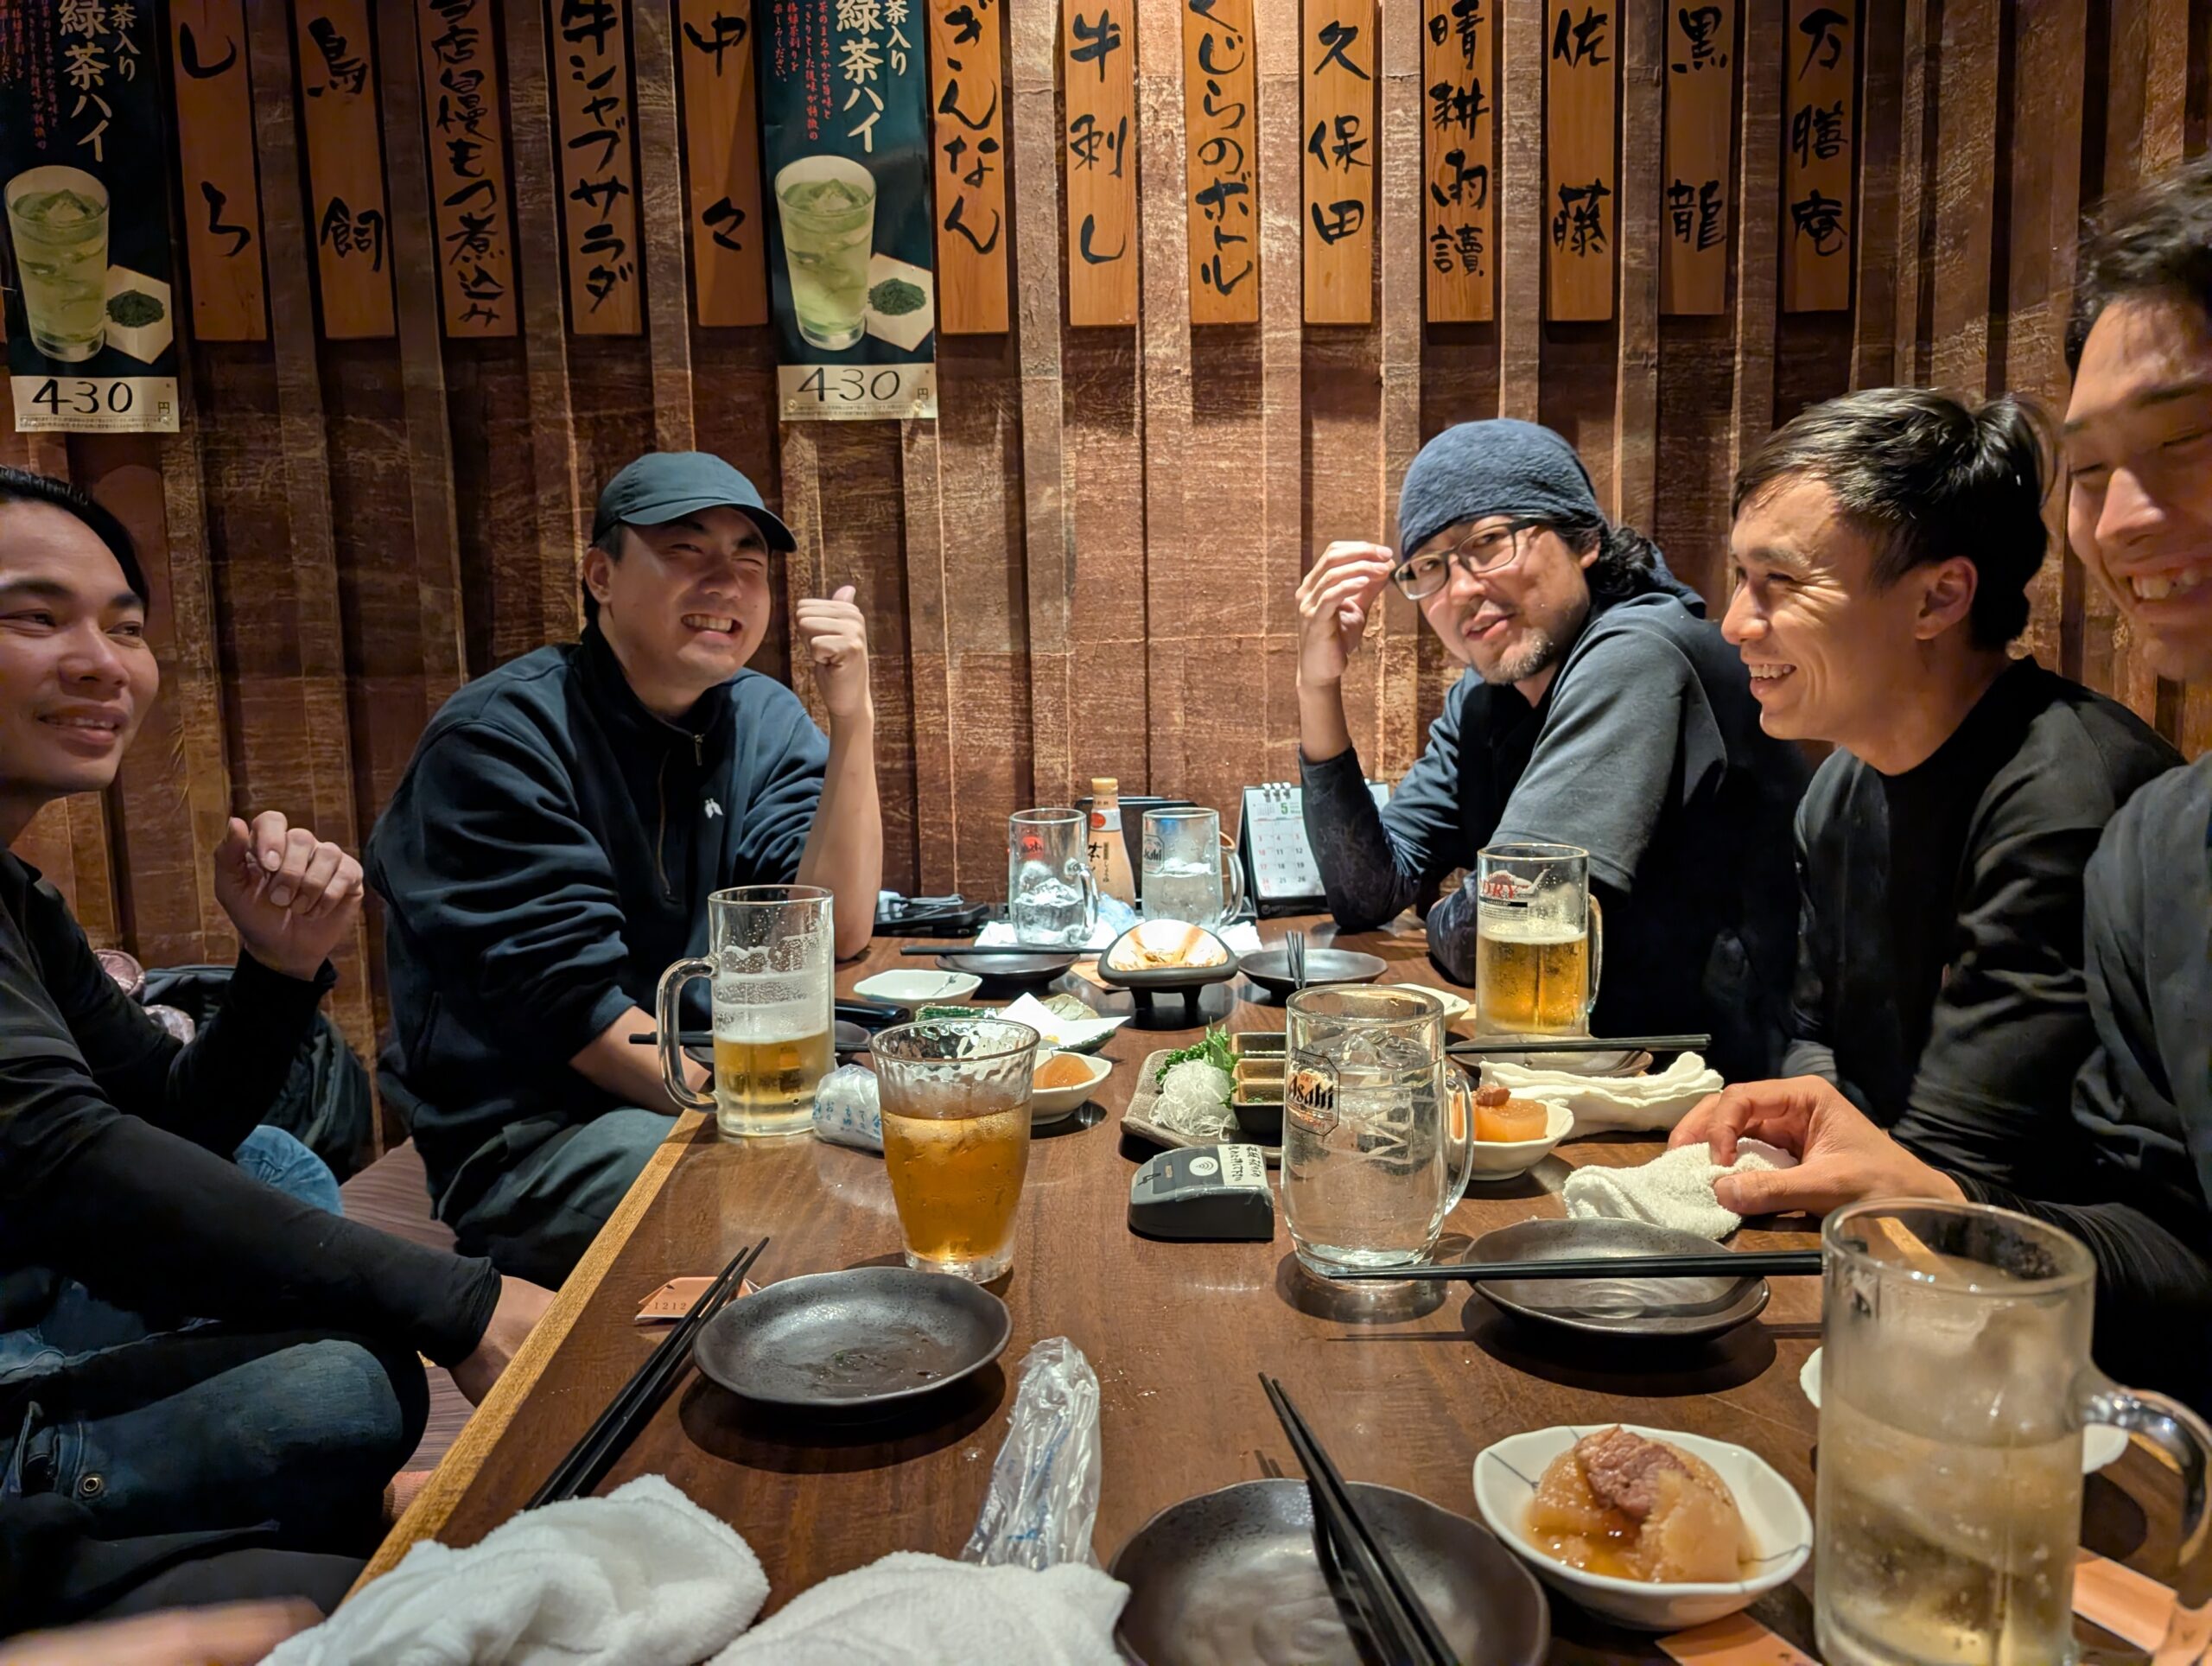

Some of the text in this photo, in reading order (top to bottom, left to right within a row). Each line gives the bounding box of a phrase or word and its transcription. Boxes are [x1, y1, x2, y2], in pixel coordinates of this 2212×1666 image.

[58, 0, 113, 162] 緑茶ハイ
[109, 3, 141, 82] 茶入り
[836, 0, 886, 153] 緑茶ハイ
[883, 0, 912, 76] 茶入り
[308, 17, 384, 271] 鳥飼
[560, 0, 632, 312] 牛シャブサラダ
[684, 12, 746, 251] 中々
[938, 0, 1000, 254] ぎんなん
[1070, 9, 1128, 264] 牛刺し
[1307, 20, 1371, 245] 久保田
[1552, 6, 1611, 258] 佐藤
[1668, 6, 1728, 251] 黒龍
[1791, 9, 1849, 257] 万膳庵
[32, 378, 170, 415] 430 円
[798, 367, 928, 402] 430 円
[1281, 802, 1288, 815] 5
[1482, 880, 1519, 900] DRY
[1287, 1075, 1334, 1110] Asahi
[655, 1301, 687, 1310] 1212
